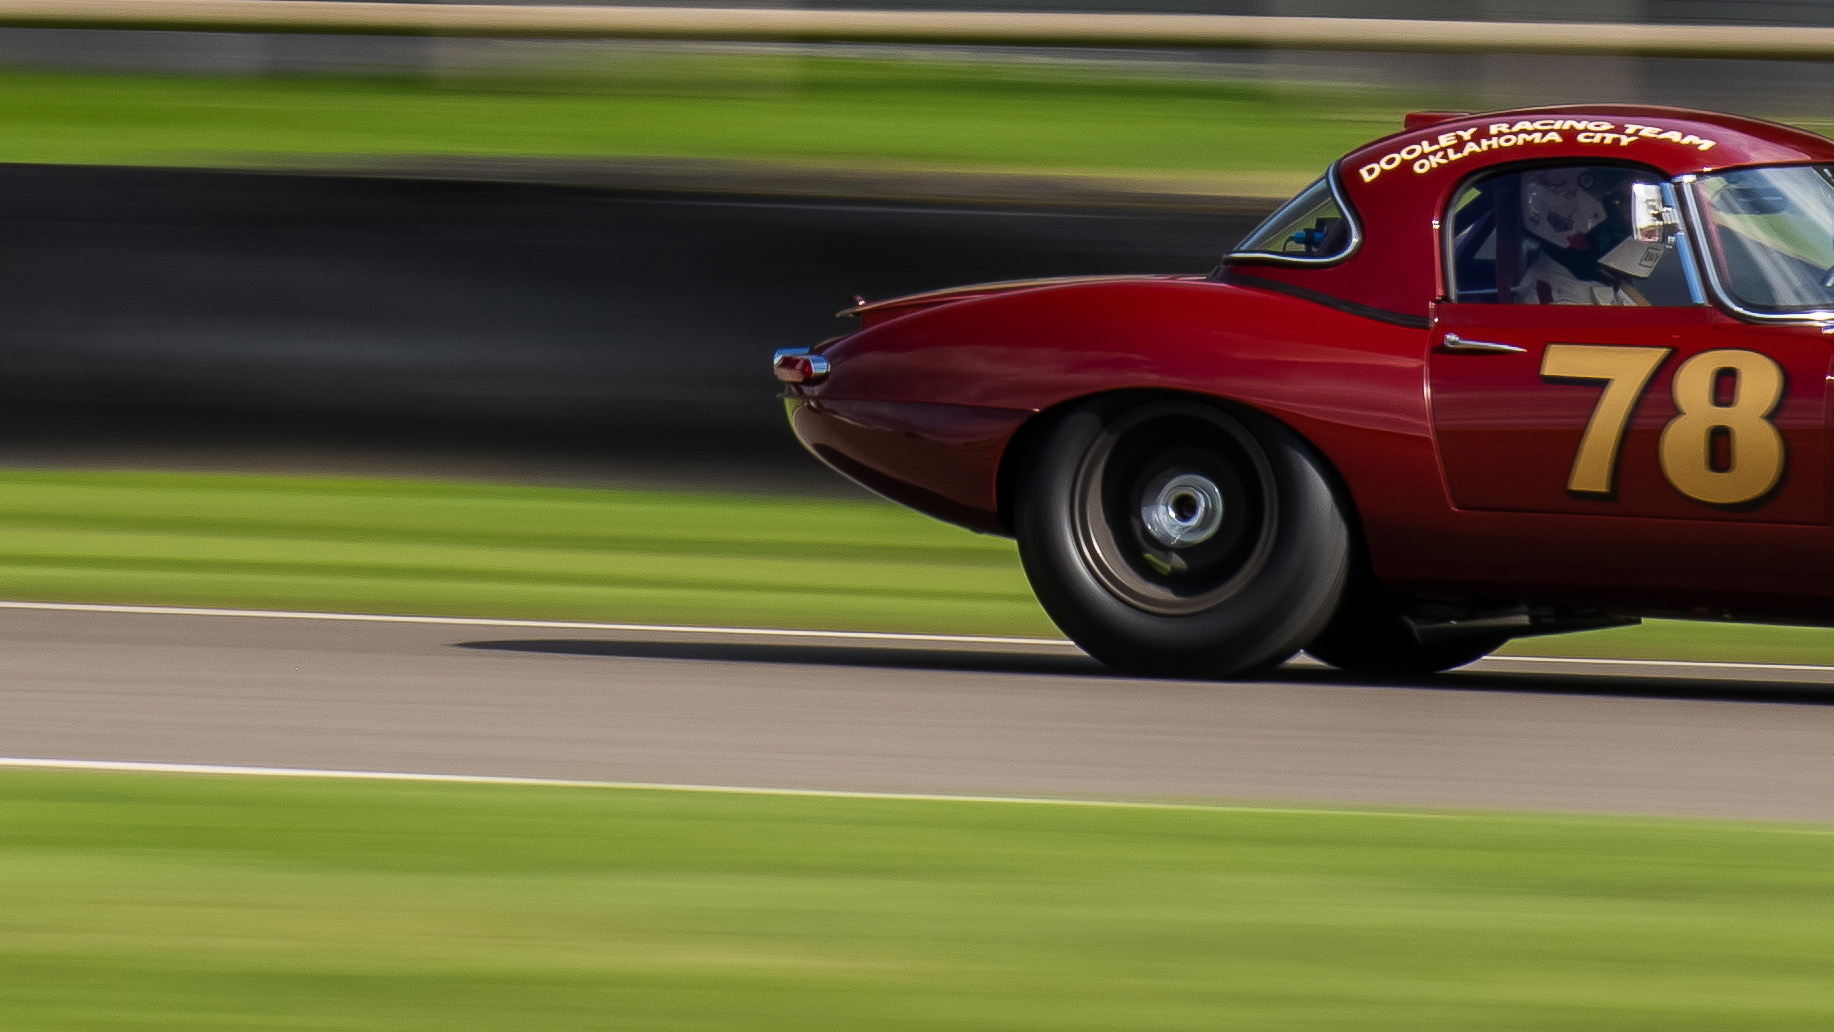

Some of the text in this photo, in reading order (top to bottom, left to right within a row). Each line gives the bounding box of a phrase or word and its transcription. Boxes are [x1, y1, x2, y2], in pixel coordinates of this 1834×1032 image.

[1358, 119, 1717, 183] DOOLEY RACING TEAM
[1412, 131, 1641, 175] OKLAHOMA CITY
[1538, 341, 1788, 506] 78
